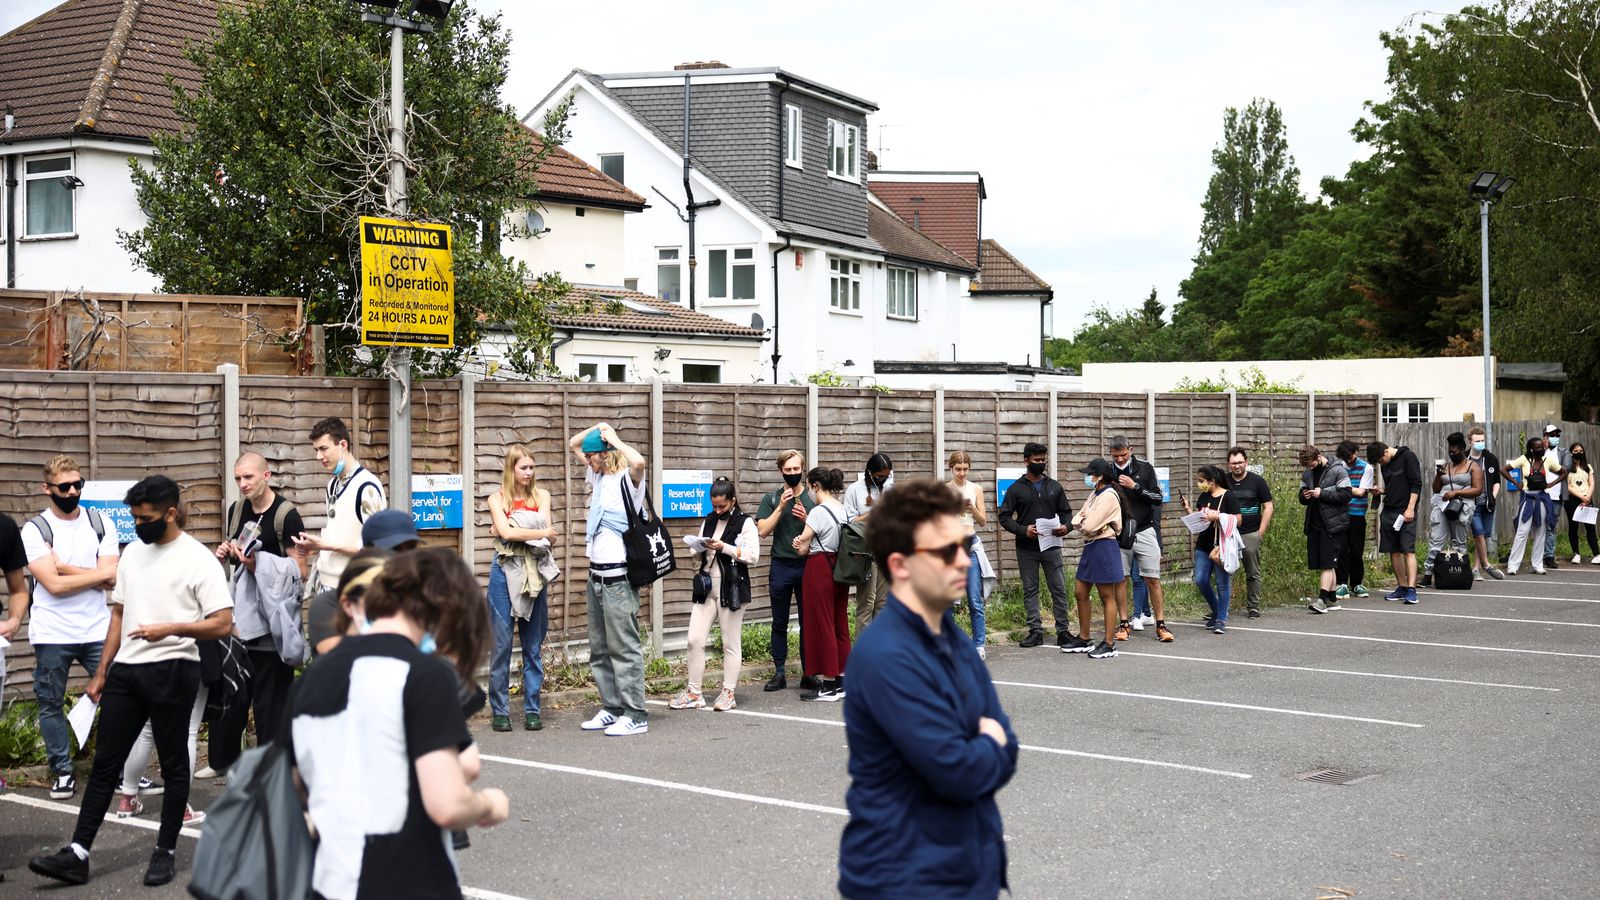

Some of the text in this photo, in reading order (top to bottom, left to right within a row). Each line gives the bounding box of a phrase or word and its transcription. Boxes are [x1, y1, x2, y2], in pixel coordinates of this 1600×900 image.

[372, 226, 440, 246] WARNING
[390, 255, 427, 271] CCTV
[369, 272, 449, 292] in Operation
[369, 299, 449, 312] Recorded & Monitored
[368, 310, 449, 326] 24 HOURS A DAY
[668, 488, 705, 498] Reserved for
[411, 496, 452, 507] served for
[671, 502, 678, 511] Dr
[117, 519, 136, 529] Prac
